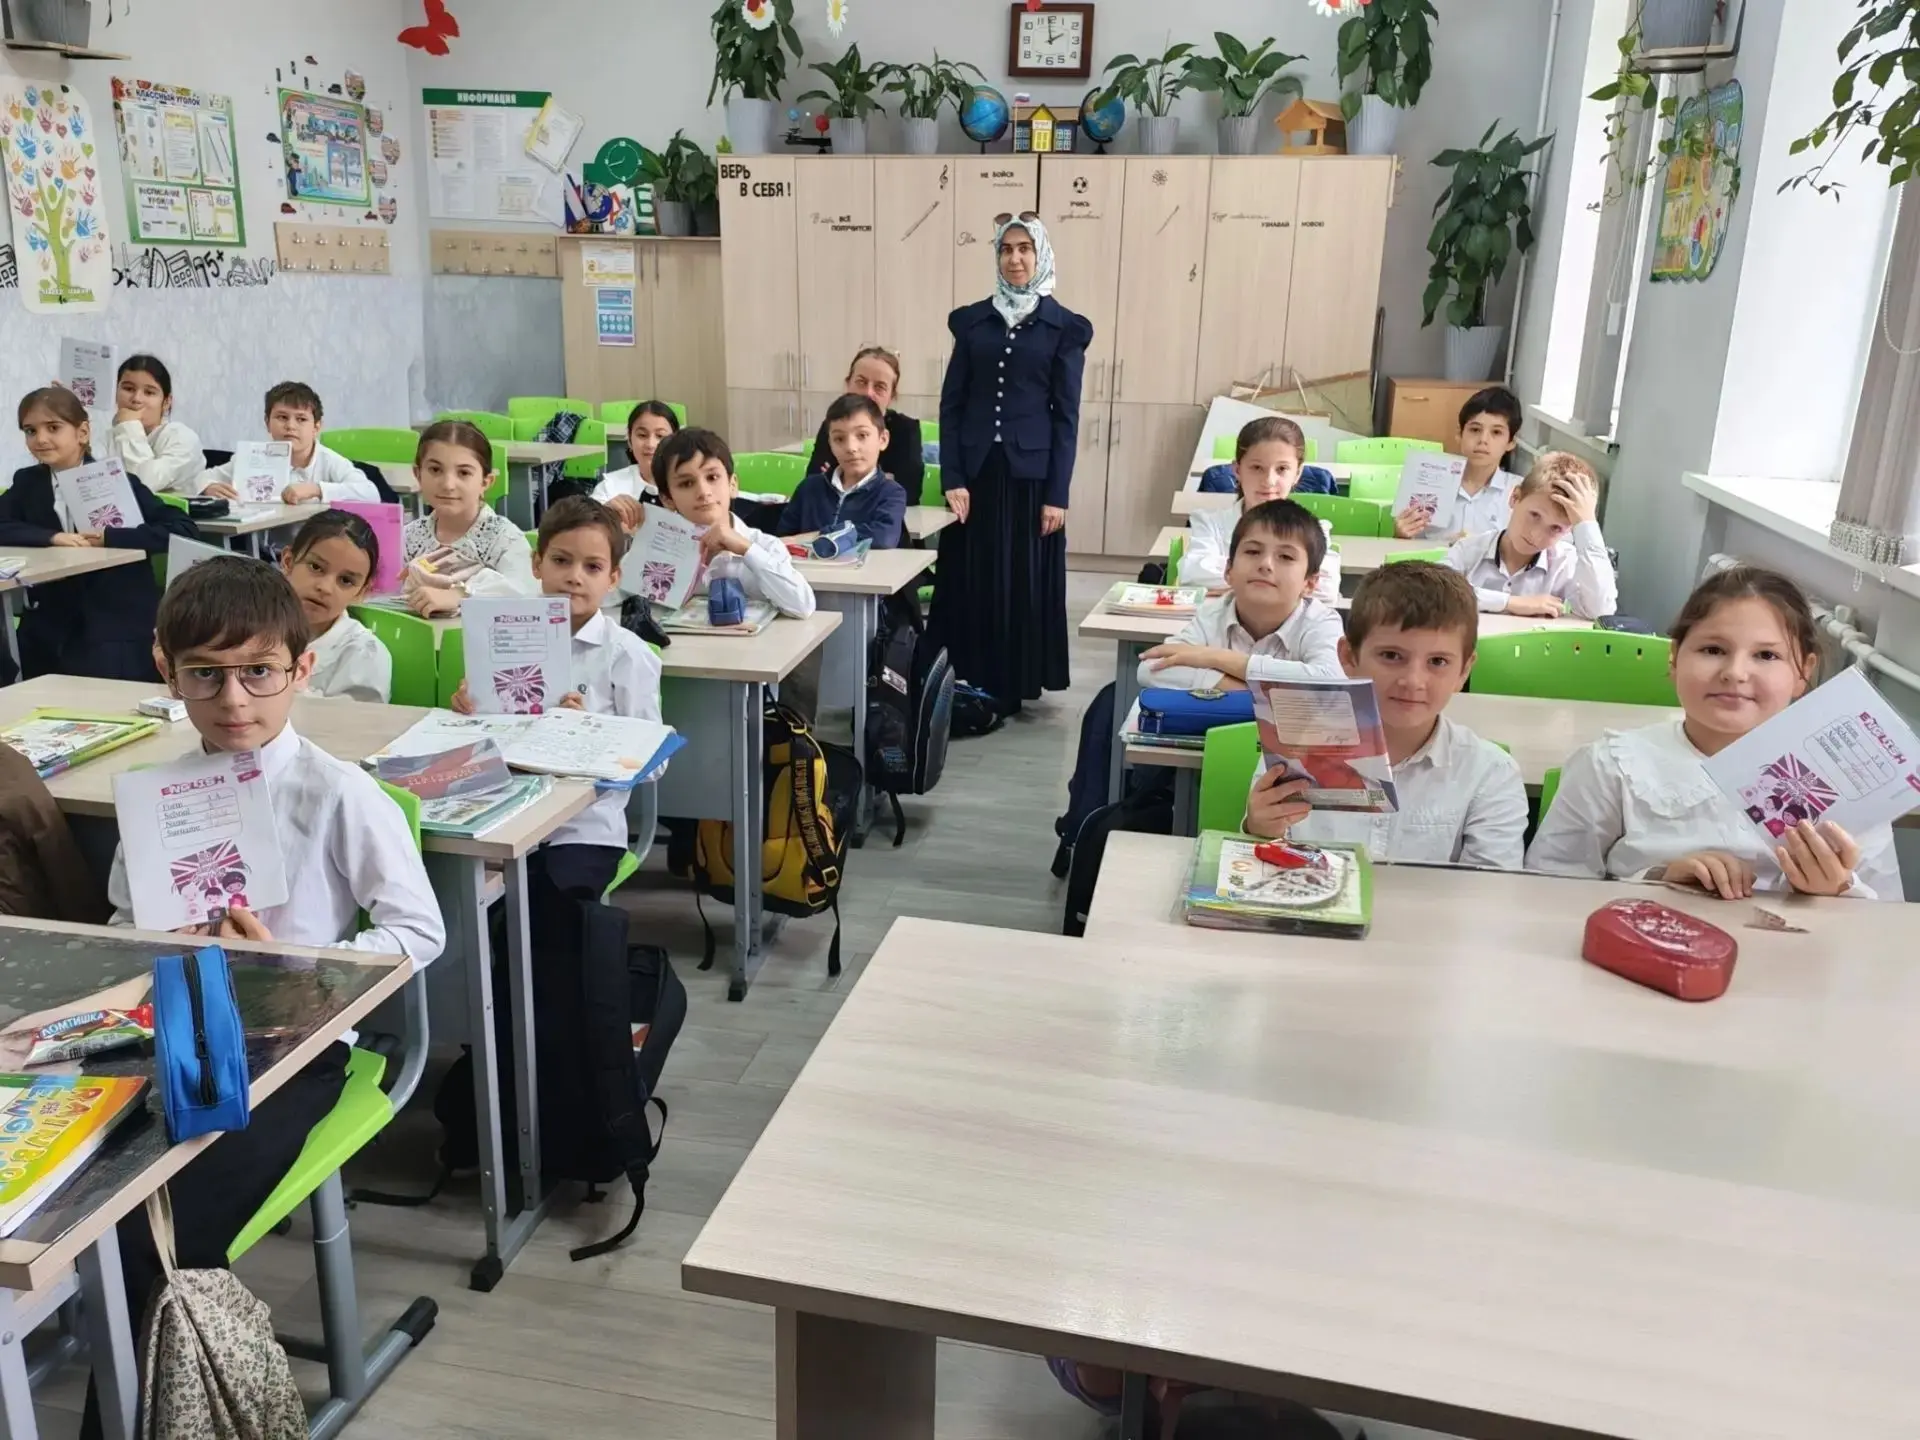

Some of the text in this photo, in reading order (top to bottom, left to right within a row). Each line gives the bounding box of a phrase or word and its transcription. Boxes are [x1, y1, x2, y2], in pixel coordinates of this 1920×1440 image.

[136, 89, 201, 106] КЛАССНЫЙ УГОЛОК
[457, 92, 517, 105] ИНФОРМАЦИЯ
[720, 164, 751, 179] ВЕРЬ
[740, 182, 748, 197] В
[752, 182, 784, 197] СЕБЯ
[1859, 711, 1907, 765] ENGLISH
[161, 775, 225, 796] ENGLISH
